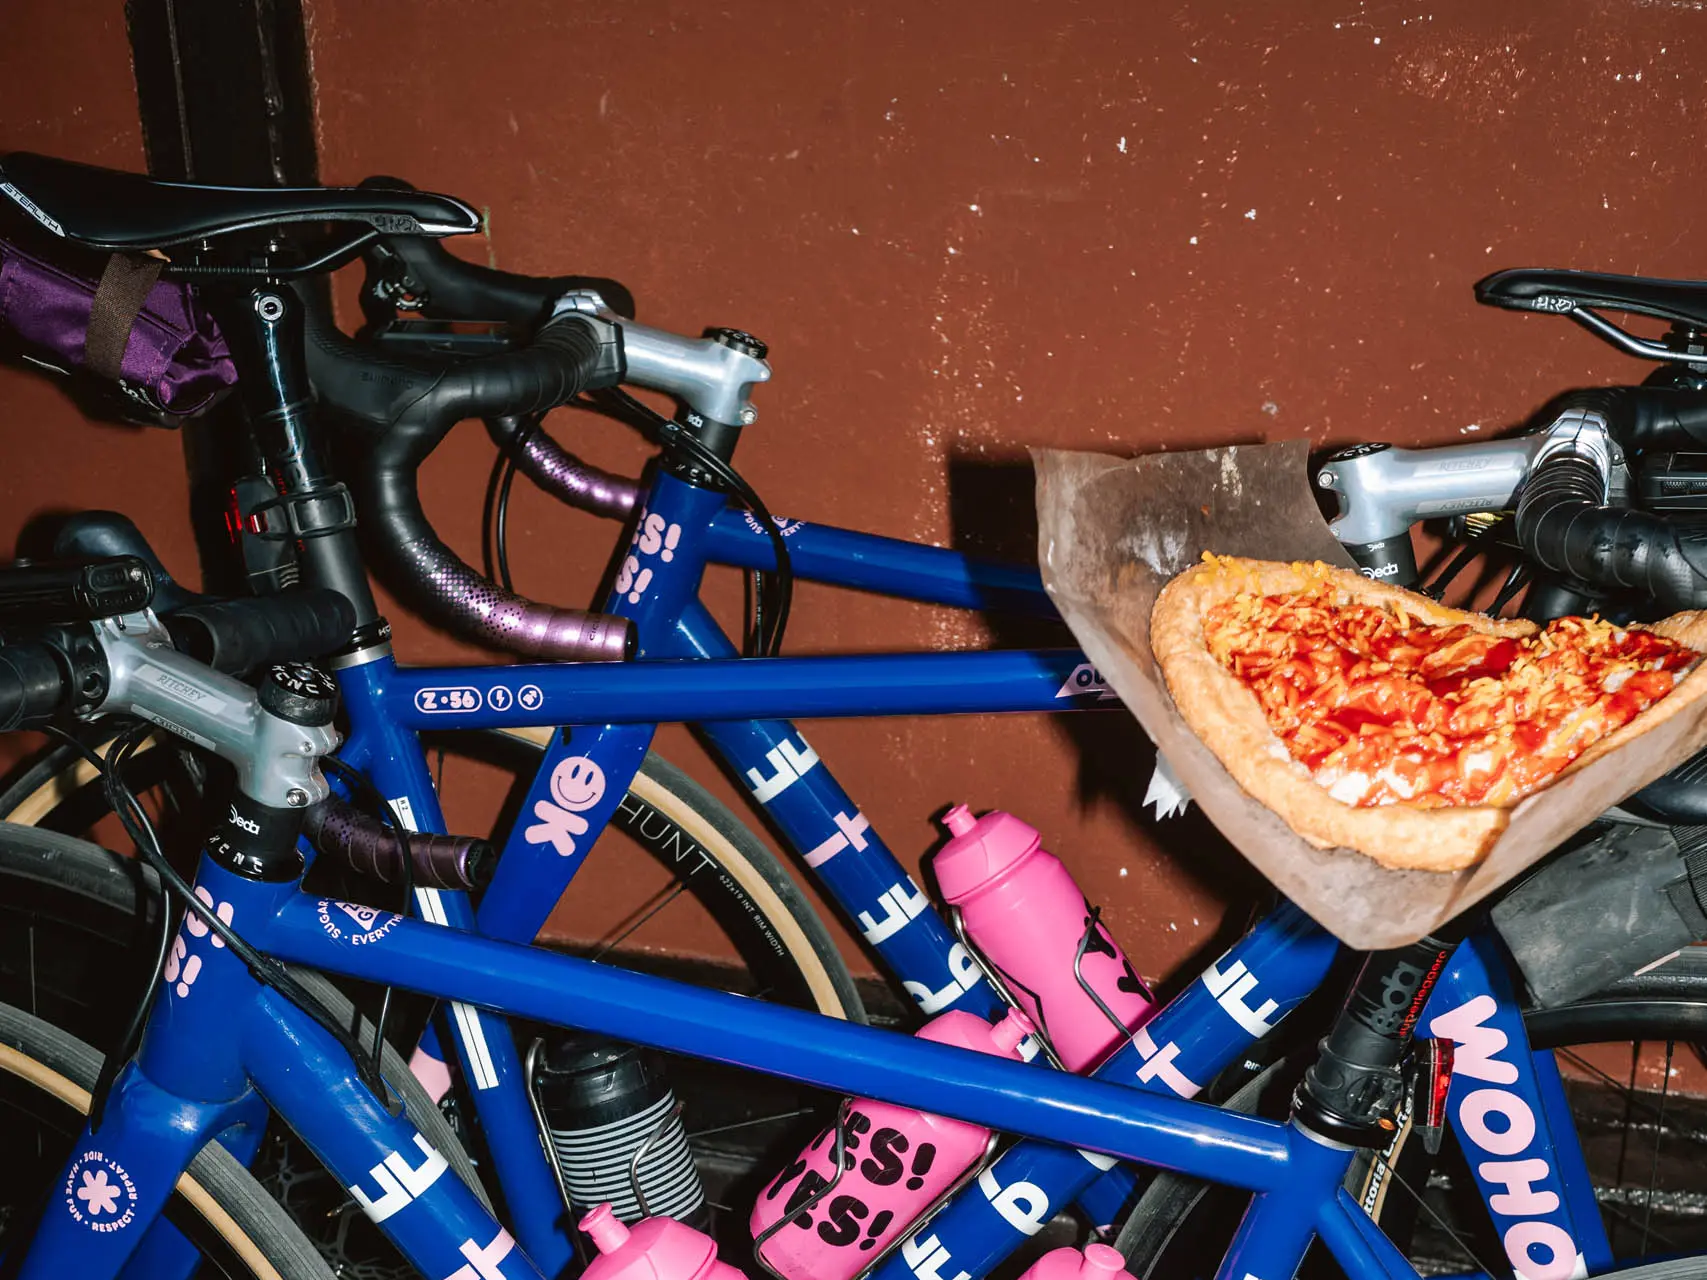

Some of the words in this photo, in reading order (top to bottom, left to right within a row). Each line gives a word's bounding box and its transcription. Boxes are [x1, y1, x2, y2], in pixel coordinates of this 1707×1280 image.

[3, 183, 59, 232] STEALTH
[156, 674, 207, 701] RITCHEY
[229, 803, 260, 835] Deda
[616, 793, 718, 877] HUNT
[719, 875, 744, 900] 622x19
[741, 898, 755, 914] INT
[752, 915, 767, 932] RIM
[764, 929, 785, 957] WIDTH
[83, 1150, 103, 1162] RIDE
[66, 1163, 80, 1195] HAVE
[109, 1161, 138, 1200] REPEAT
[66, 1198, 83, 1222] FUN
[91, 1208, 135, 1232] RESPECT
